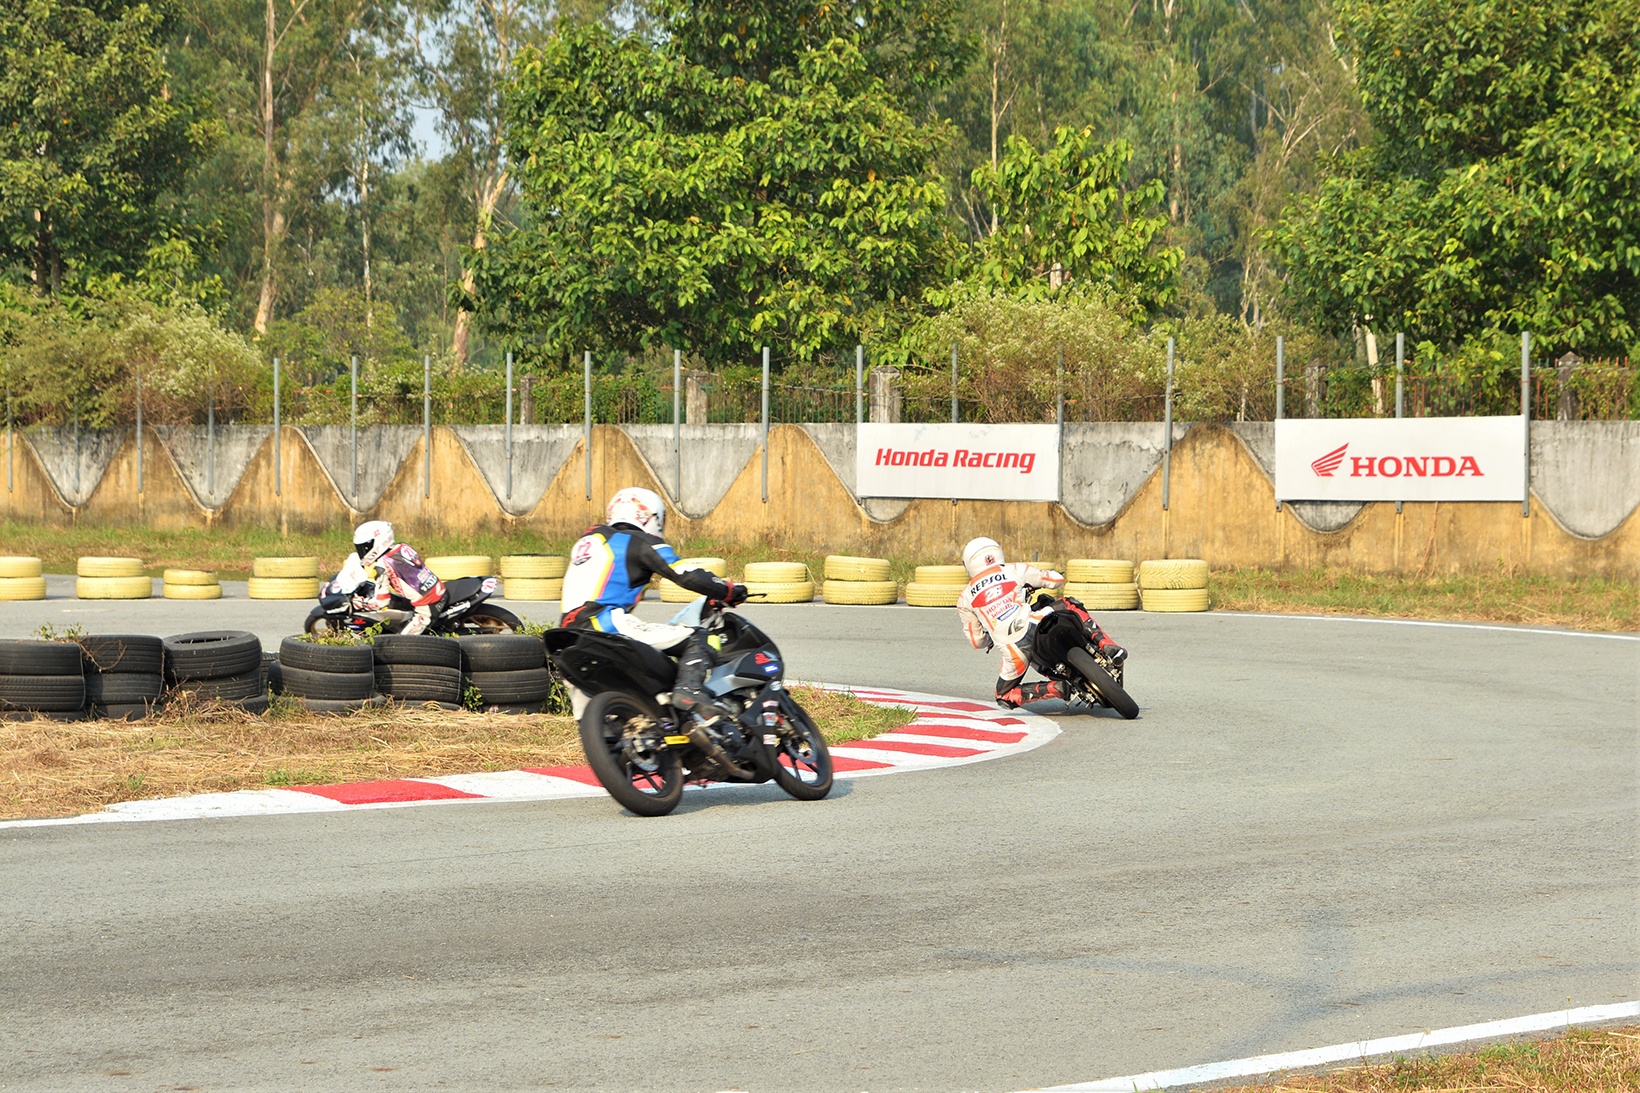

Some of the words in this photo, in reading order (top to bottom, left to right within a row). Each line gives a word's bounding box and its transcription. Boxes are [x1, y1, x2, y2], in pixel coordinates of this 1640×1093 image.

[875, 448, 949, 467] Honda
[952, 449, 1036, 474] Racing
[1350, 456, 1485, 477] HONDA
[970, 573, 1008, 597] REPSOL
